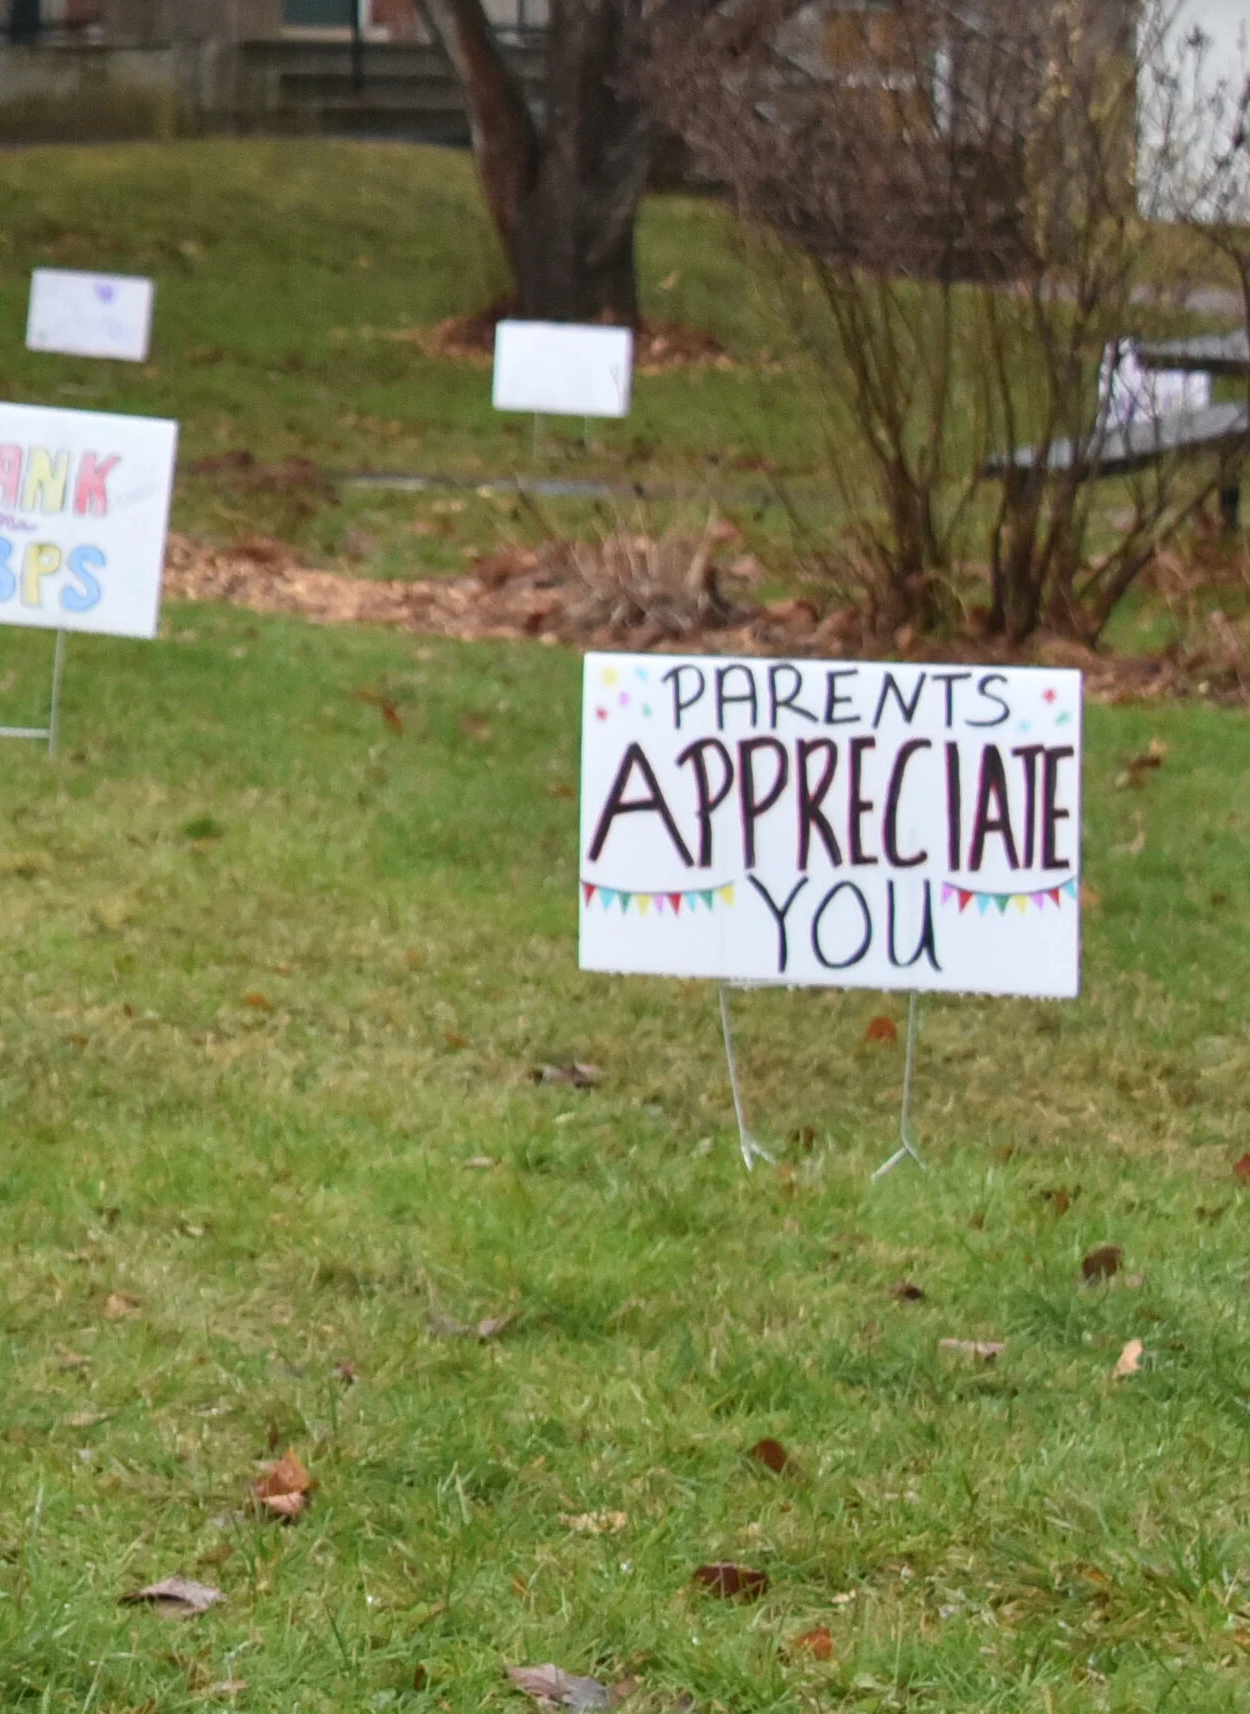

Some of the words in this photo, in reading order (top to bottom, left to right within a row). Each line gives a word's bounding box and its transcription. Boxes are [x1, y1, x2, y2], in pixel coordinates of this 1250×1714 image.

[662, 663, 1011, 731] PARENTS
[587, 737, 1075, 872] APPRECIATE
[747, 874, 943, 973] YOU
